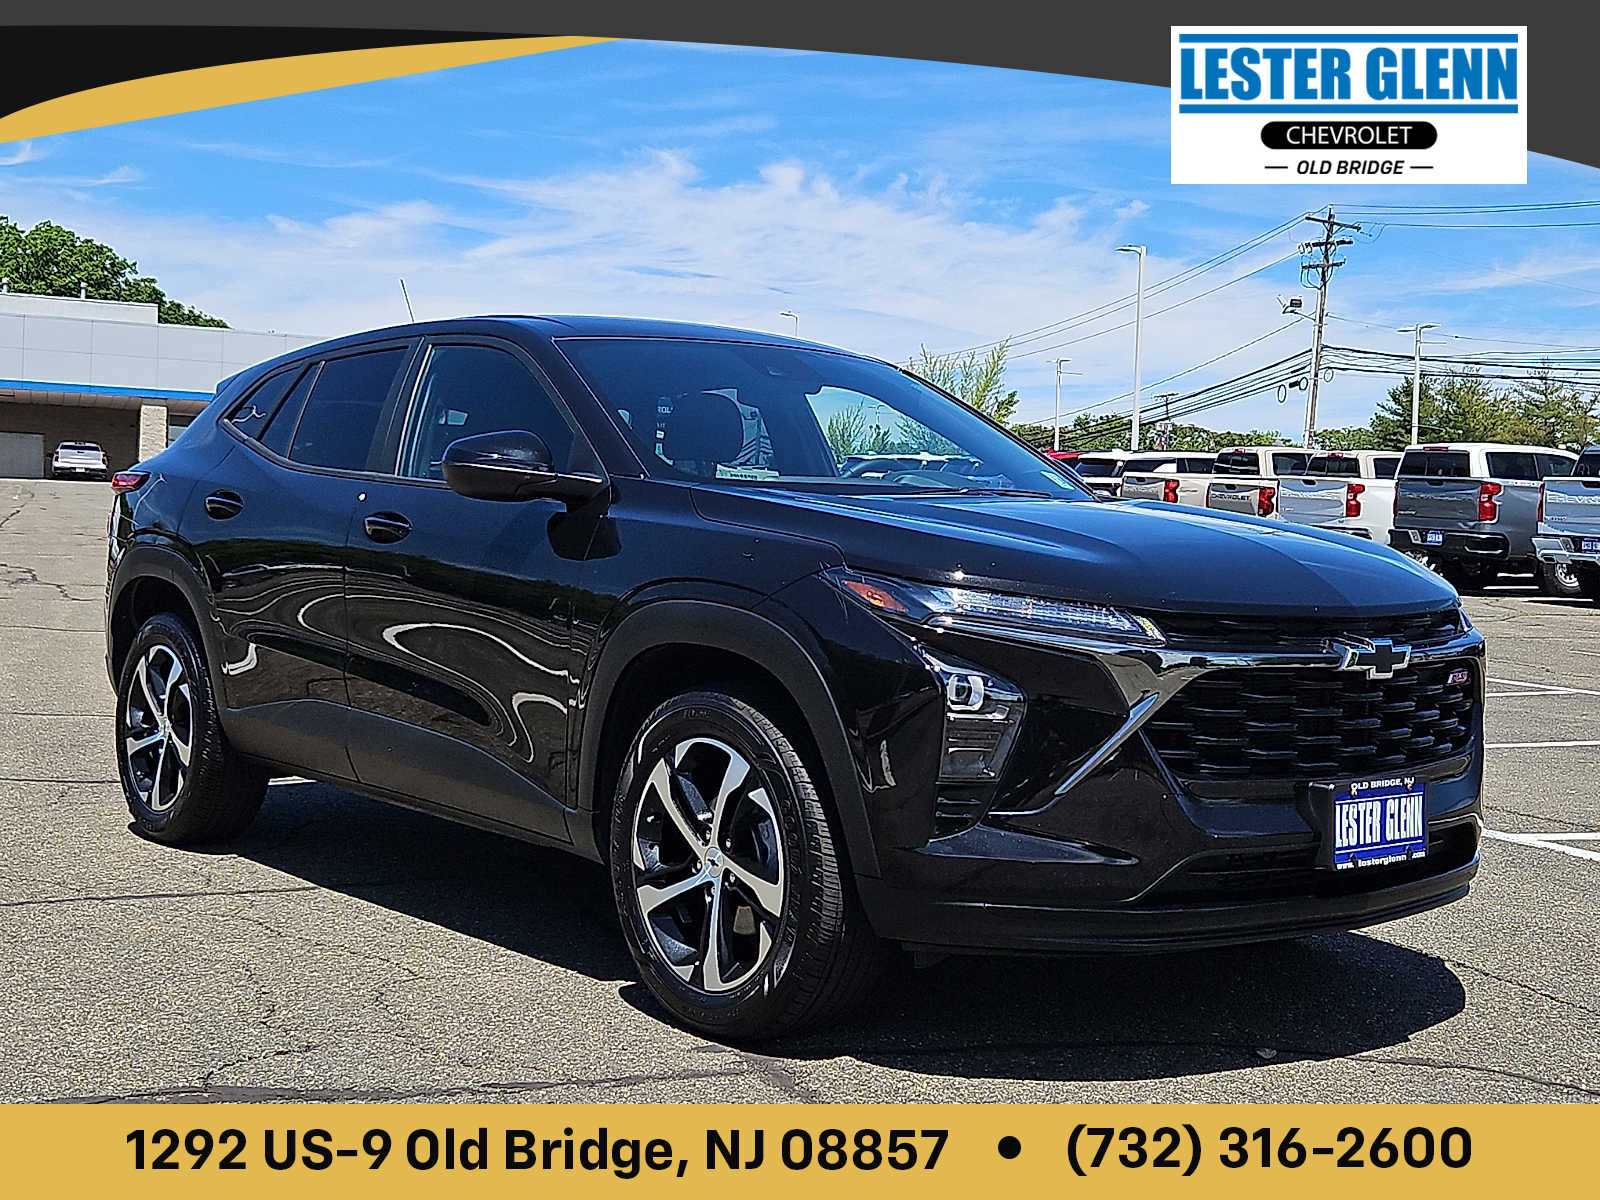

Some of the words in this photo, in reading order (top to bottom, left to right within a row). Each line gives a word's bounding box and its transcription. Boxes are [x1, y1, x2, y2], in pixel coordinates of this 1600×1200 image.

[1370, 779, 1402, 788] BRIDGE,
[1335, 801, 1381, 847] LESTER
[1385, 796, 1422, 841] GLENN
